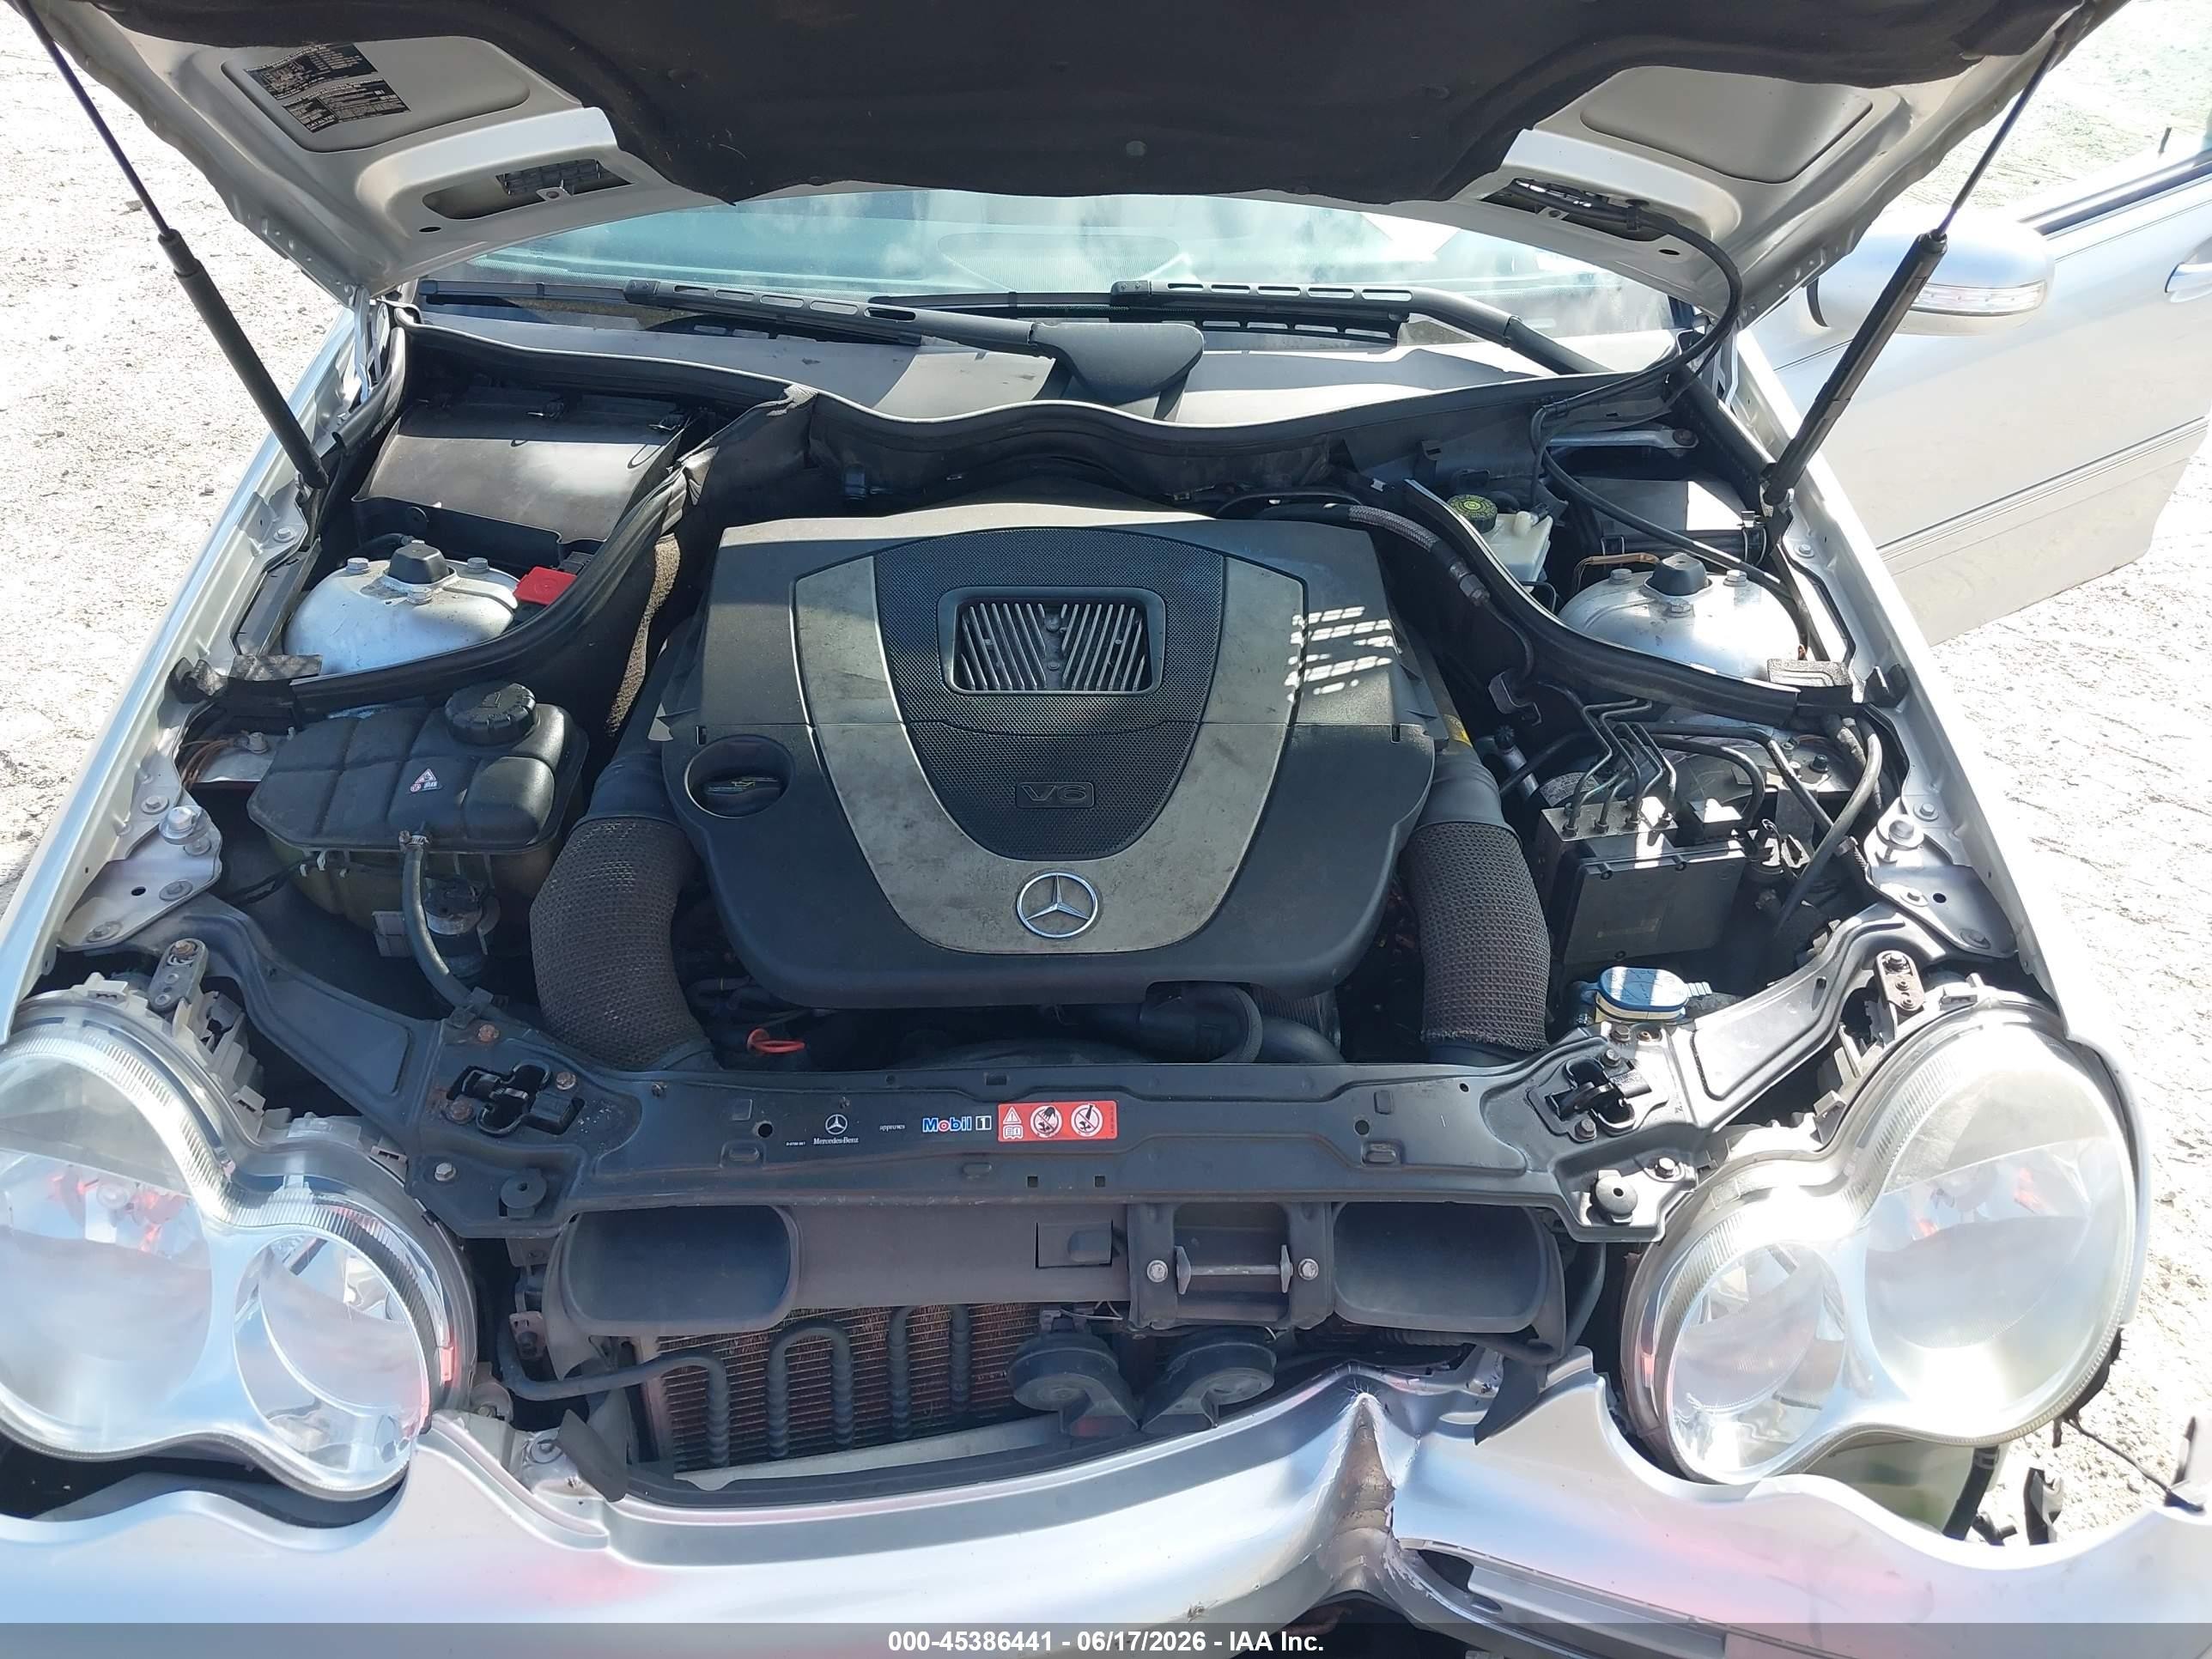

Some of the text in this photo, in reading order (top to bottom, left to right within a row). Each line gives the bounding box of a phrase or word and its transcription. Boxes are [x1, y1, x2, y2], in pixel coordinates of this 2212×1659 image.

[1021, 785, 1086, 801] V6
[922, 1115, 991, 1133] Mobil 1
[813, 1136, 859, 1146] Mercedes-Benz
